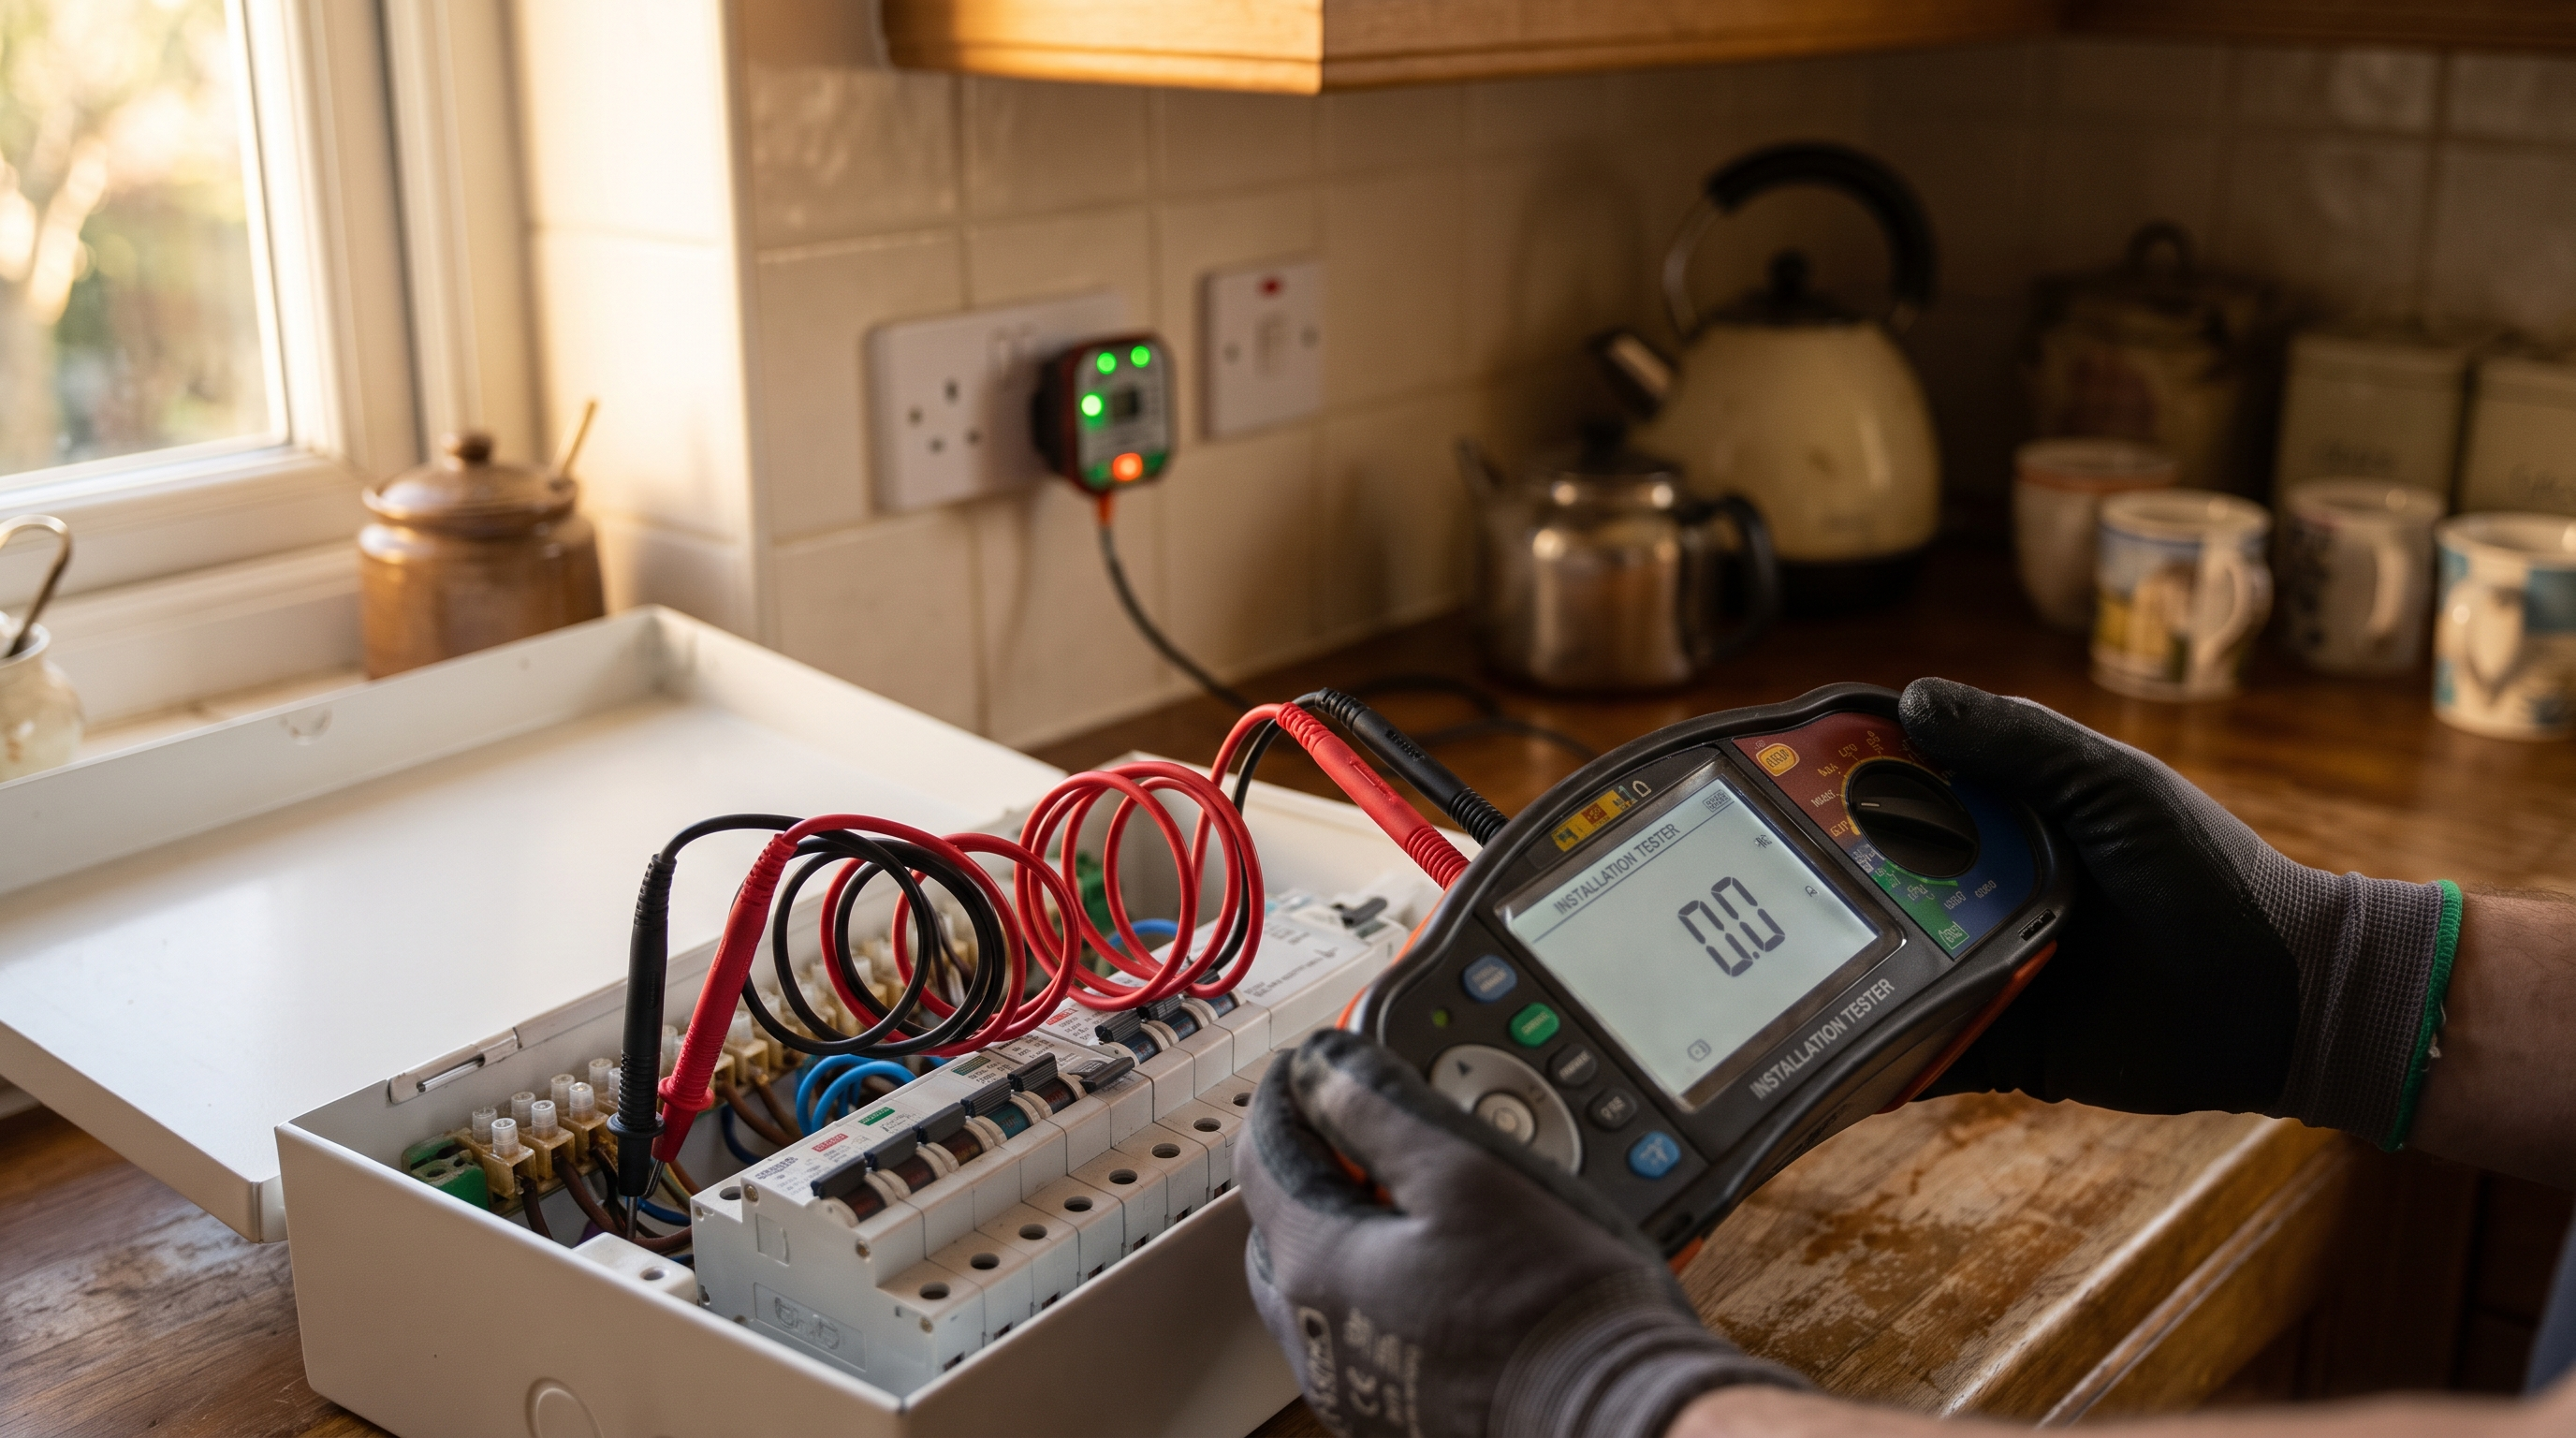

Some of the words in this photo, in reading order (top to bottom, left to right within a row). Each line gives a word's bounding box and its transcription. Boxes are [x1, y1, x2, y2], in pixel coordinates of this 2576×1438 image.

[1553, 851, 1638, 916] INSTALLATION
[1632, 823, 1681, 858] TESTER
[1677, 876, 1786, 977] 0.0
[1749, 1016, 1848, 1100] INSTALLATION
[1840, 977, 1895, 1024] TESTER
